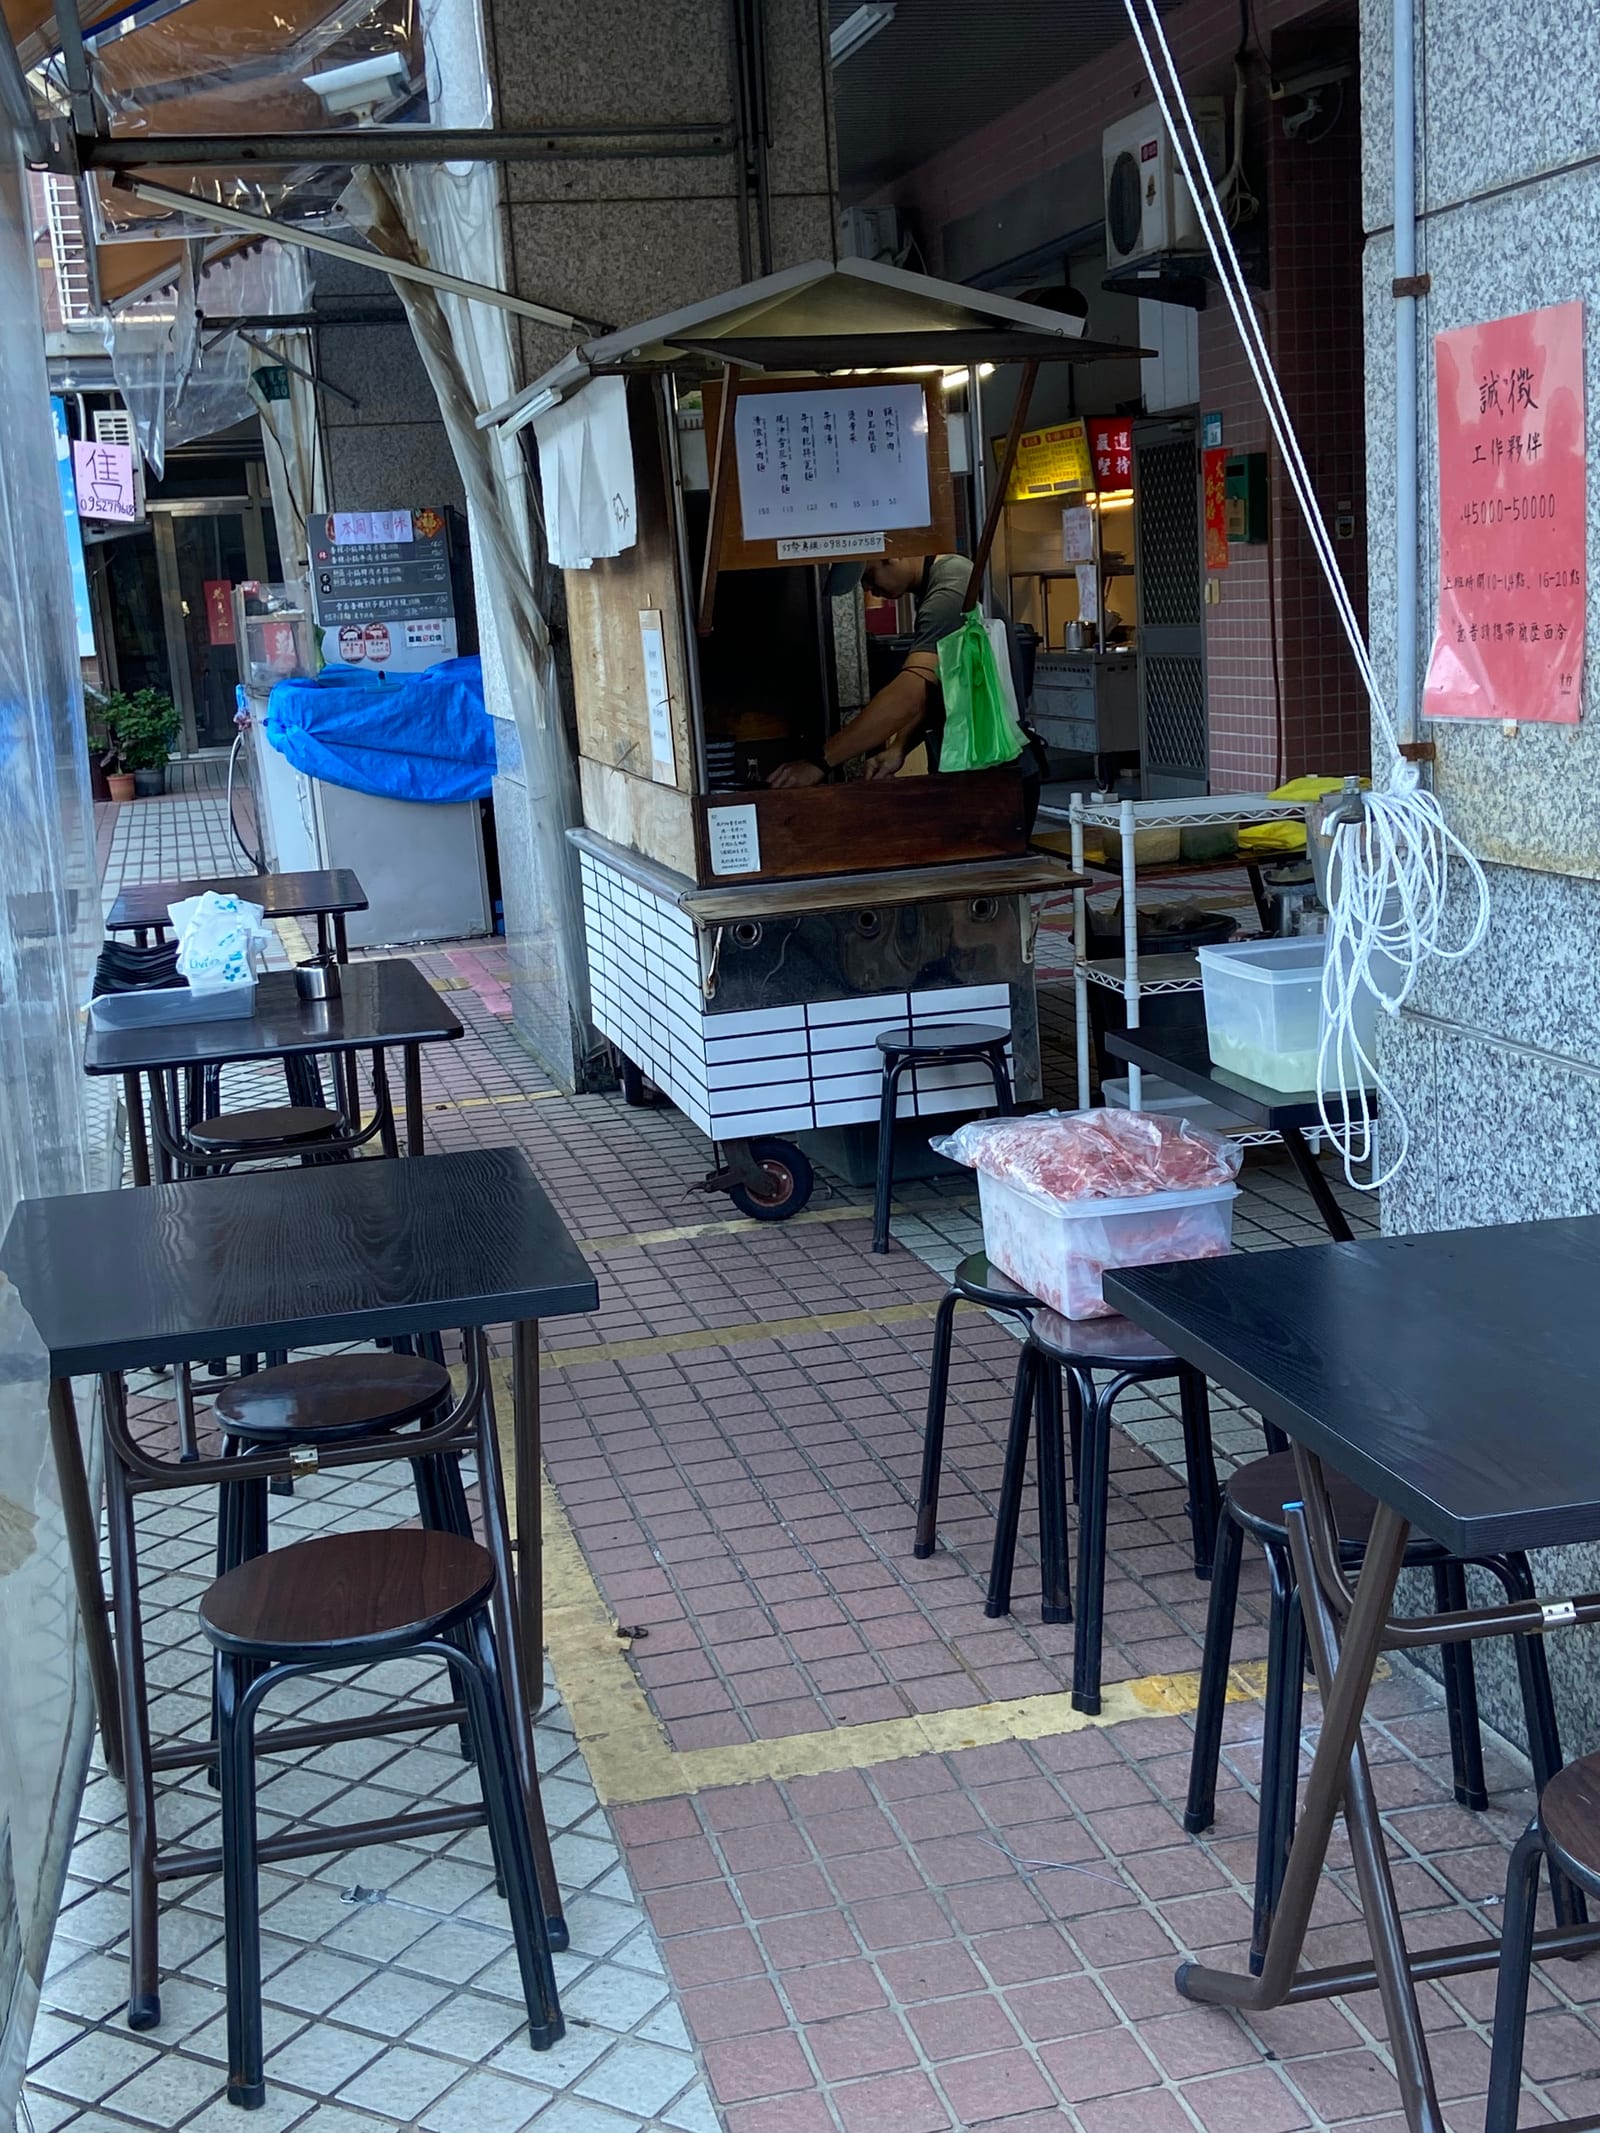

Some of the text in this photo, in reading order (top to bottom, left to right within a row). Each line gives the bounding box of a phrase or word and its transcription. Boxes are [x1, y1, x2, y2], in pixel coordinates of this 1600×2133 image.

[1479, 367, 1538, 416] 誠徵
[1472, 432, 1542, 466] 工作夥伴
[1463, 493, 1555, 525] 45000-50000
